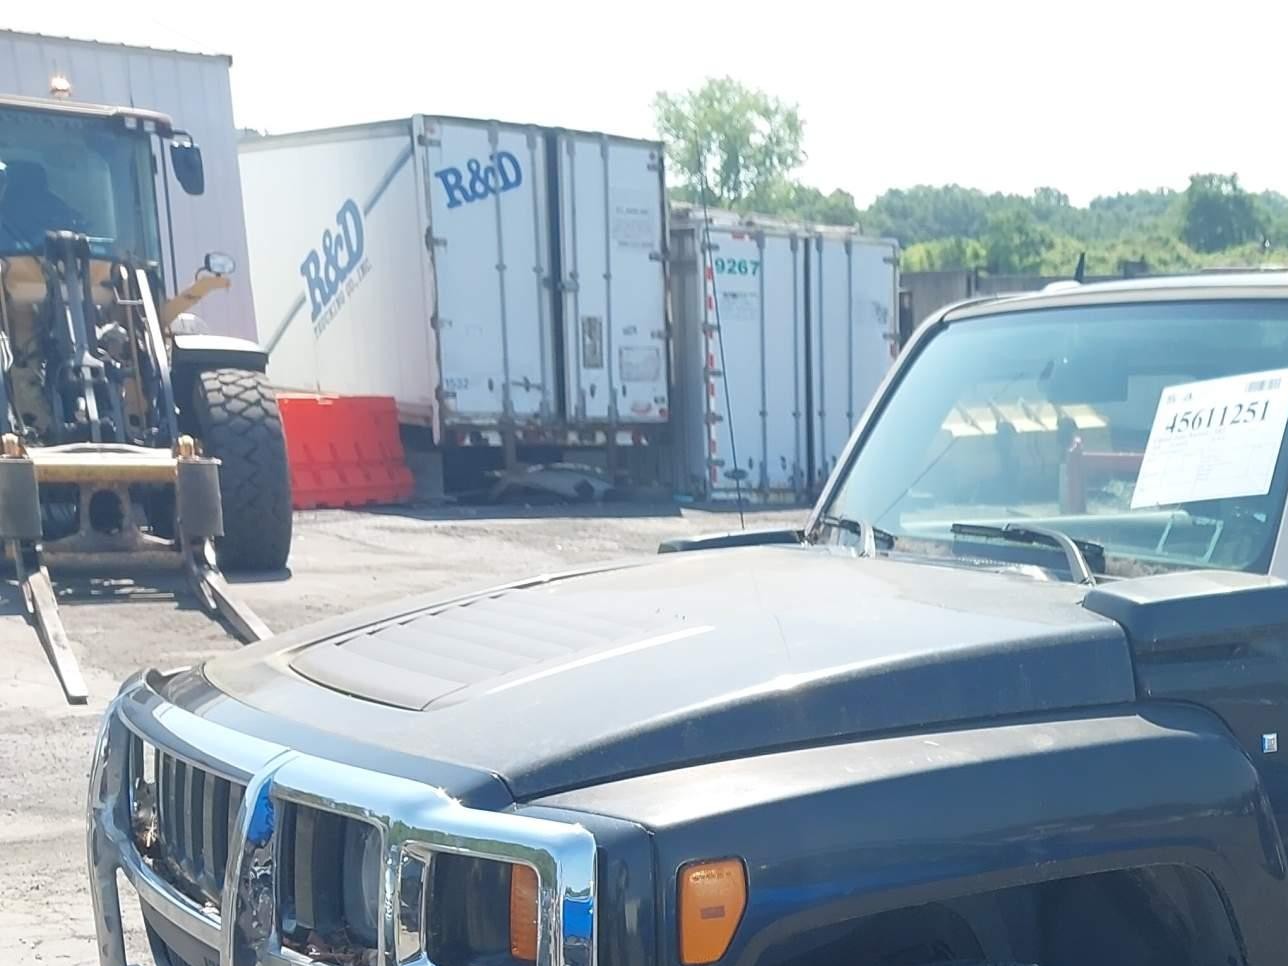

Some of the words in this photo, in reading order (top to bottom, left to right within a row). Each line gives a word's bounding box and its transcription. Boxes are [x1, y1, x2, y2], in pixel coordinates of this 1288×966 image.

[434, 151, 522, 208] R&D
[301, 198, 364, 322] R&D
[715, 257, 760, 276] 9267
[1165, 399, 1270, 433] 45611251
